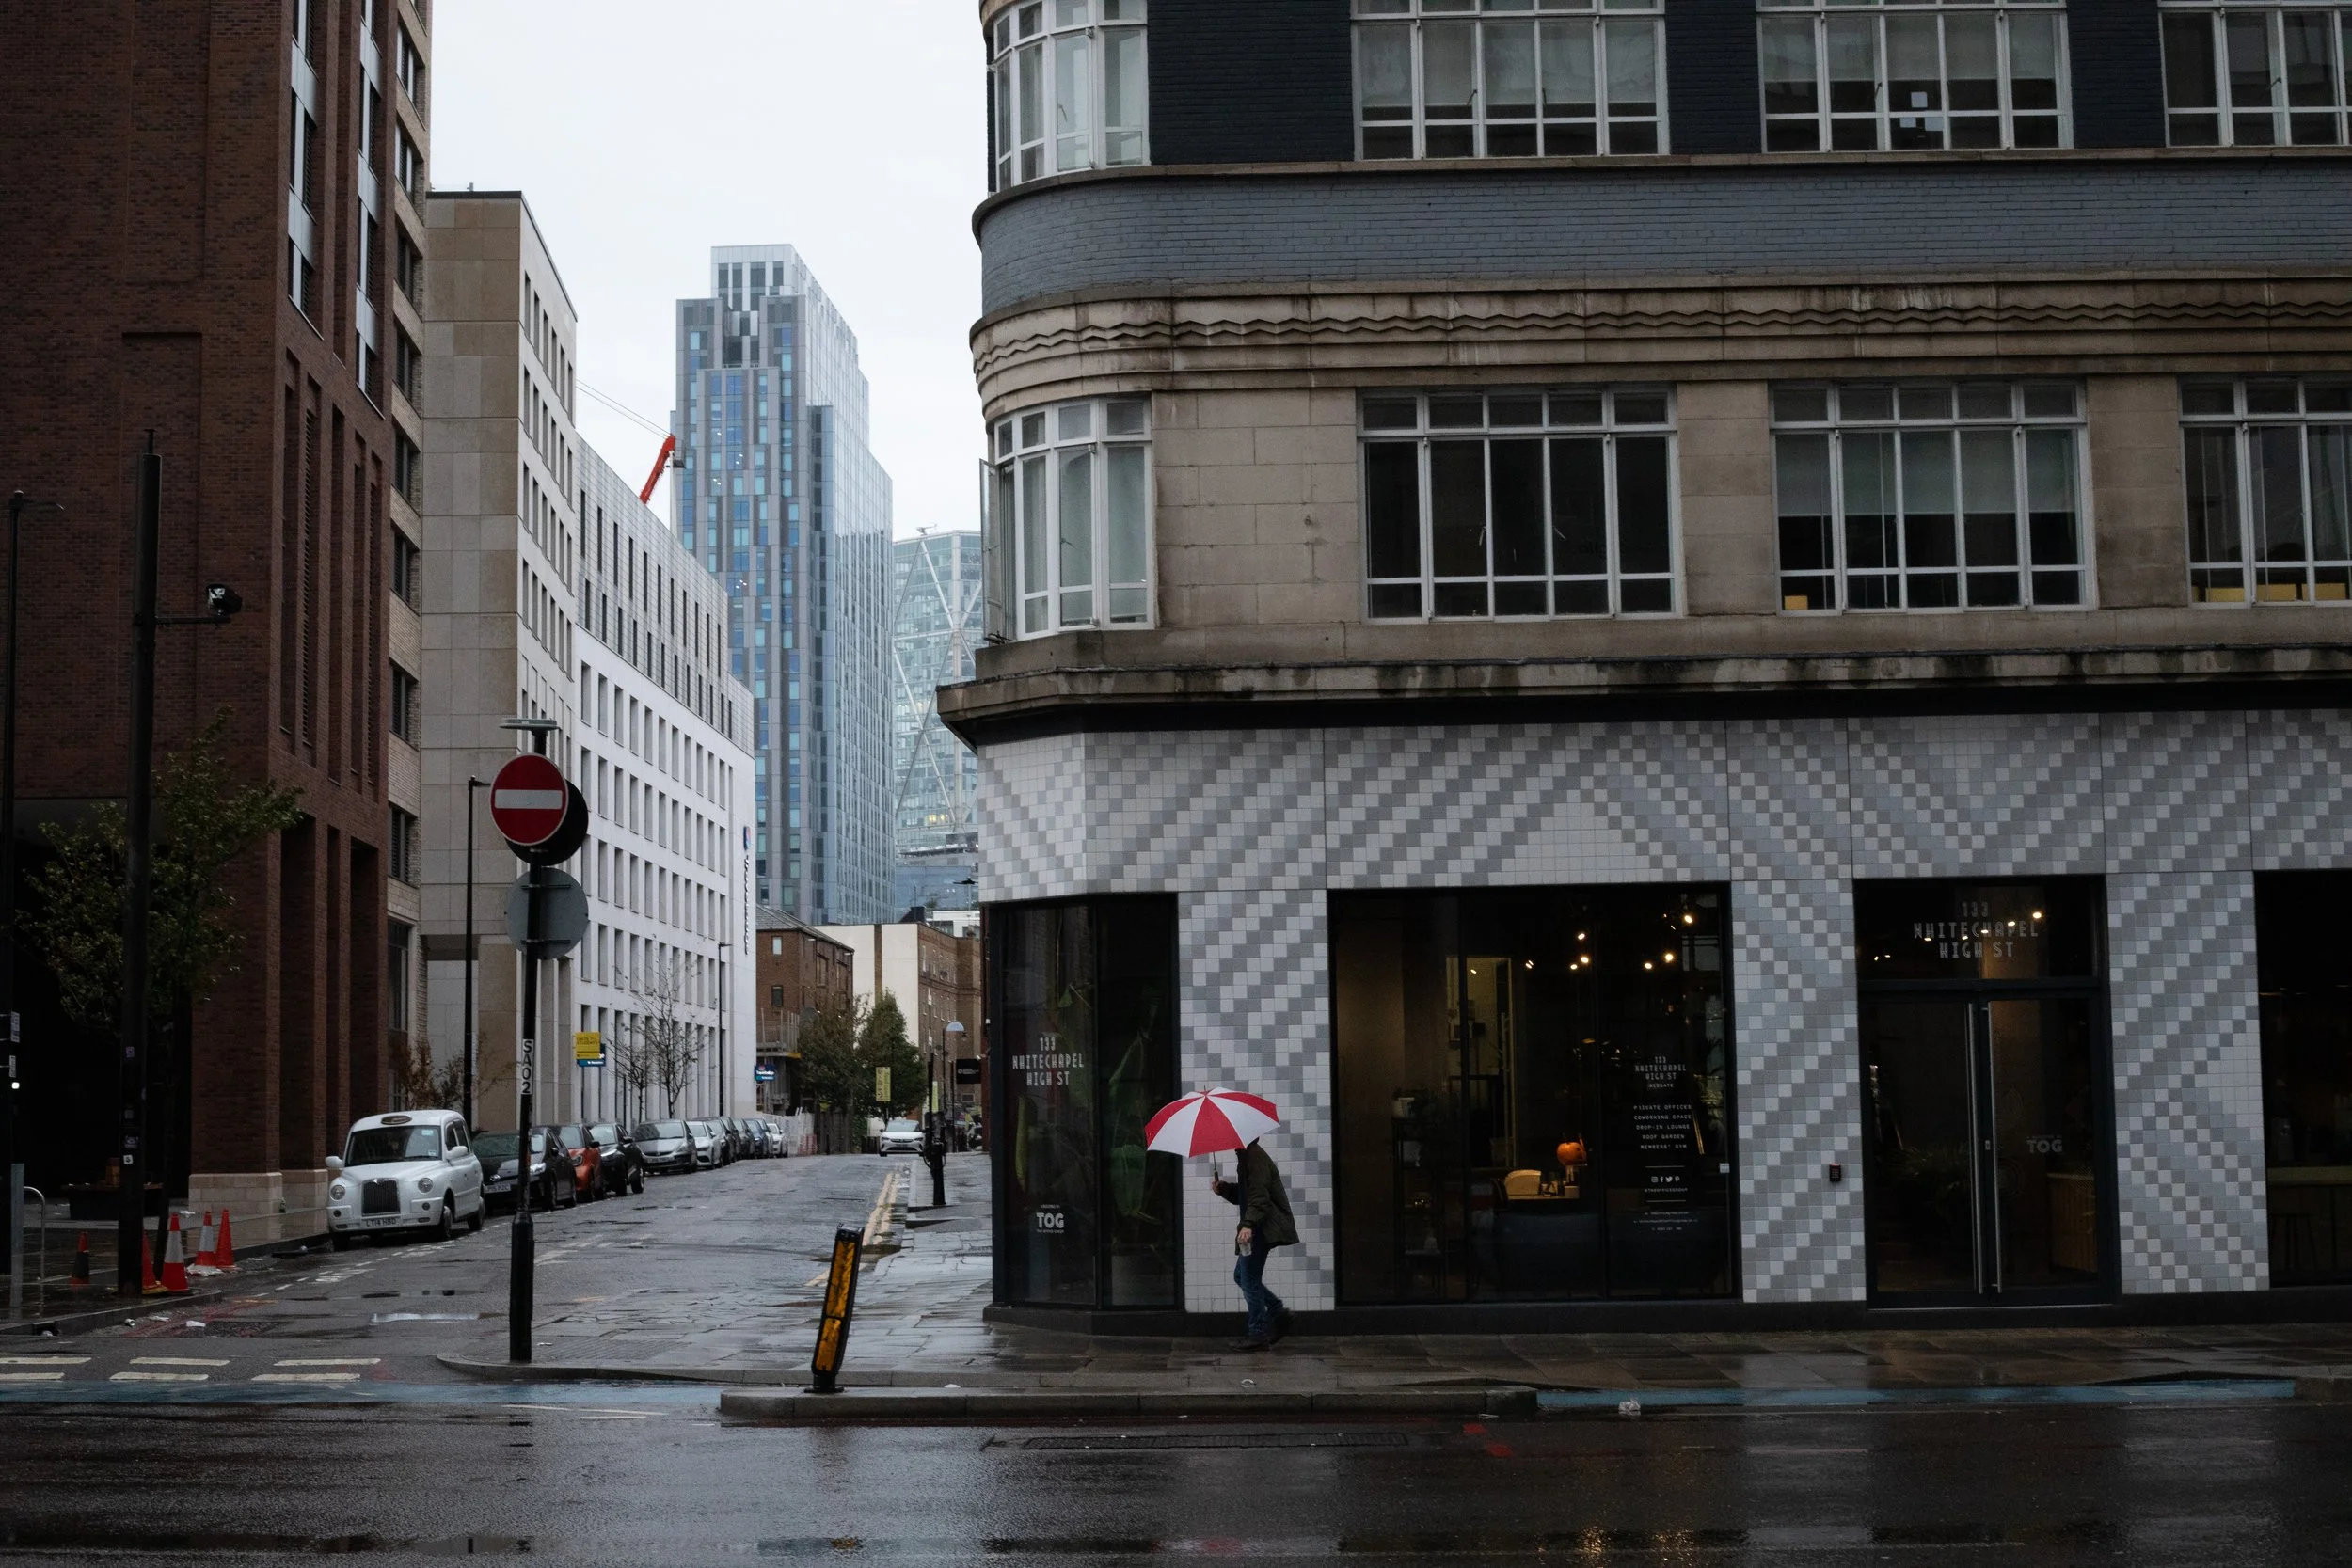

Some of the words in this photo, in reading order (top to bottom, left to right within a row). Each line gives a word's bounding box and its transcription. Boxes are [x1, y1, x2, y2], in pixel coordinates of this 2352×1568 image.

[1962, 901, 1988, 917] 133
[1914, 920, 2039, 939] WHITECHAPEL
[1939, 942, 1983, 958] HIGH
[1993, 941, 2013, 958] ST
[1039, 1037, 1056, 1052] 133
[1012, 1053, 1085, 1069] WHITECHAPEL
[1026, 1071, 1053, 1086] HIGH
[1057, 1070, 1070, 1086] ST
[2026, 1139, 2063, 1154] TOG
[1036, 1212, 1064, 1228] TOG
